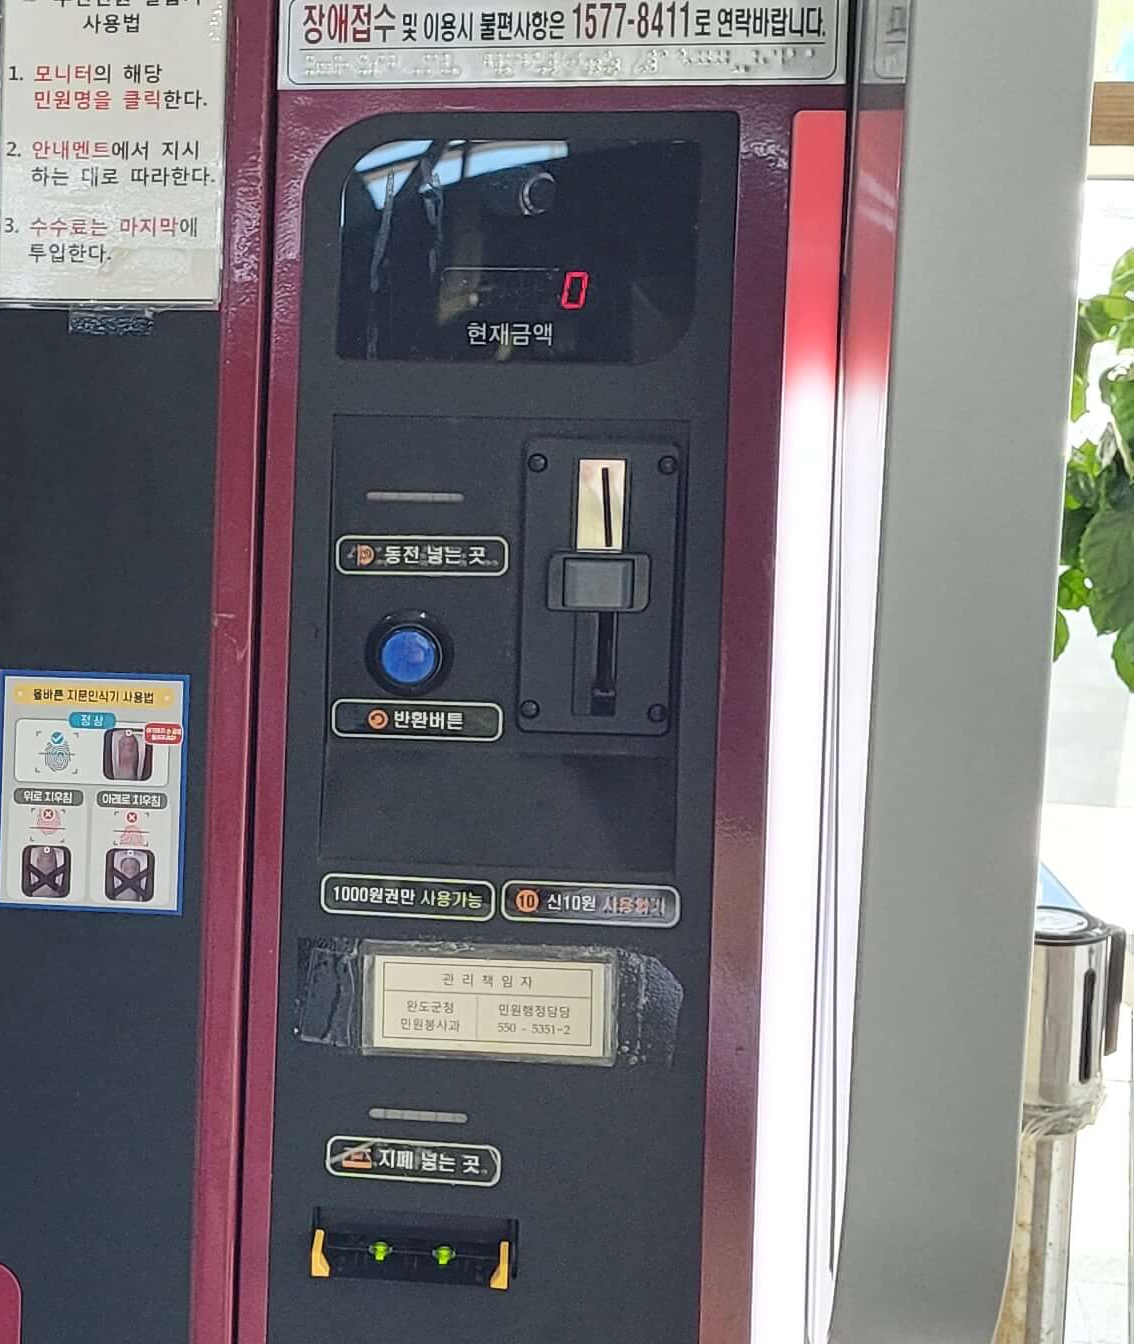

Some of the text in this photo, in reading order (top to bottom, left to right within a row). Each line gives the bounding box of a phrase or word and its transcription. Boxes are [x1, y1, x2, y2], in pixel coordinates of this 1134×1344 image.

[82, 13, 141, 35] 사용법
[302, 2, 396, 44] 장애접수
[401, 13, 417, 42] 및
[423, 12, 474, 43] 이용시
[479, 9, 566, 42] 불편사항은
[716, 5, 826, 40] 연락바랍니다.
[8, 63, 163, 85] 1. 모니터의 해당
[33, 89, 208, 111] 민원명을 클릭한다.
[6, 139, 201, 161] 2. 안내멘트에서 지시
[31, 166, 215, 187] 하는 대로 따라한다.
[3, 216, 198, 238] 3. 수수료는 마지막에
[27, 243, 112, 265] 투입한다.
[561, 271, 588, 309] 0
[466, 322, 553, 346] 현재금액
[384, 545, 486, 566] 동전 넣는 곳
[67, 689, 119, 704] 지문인식기
[123, 691, 154, 705] 사용법
[393, 710, 464, 731] 반환버튼
[333, 885, 483, 910] 1000원권만 사용가능
[547, 894, 596, 913] 신10원
[407, 1000, 454, 1015] 완도군청
[498, 1003, 570, 1019] 민원행정담당
[400, 1017, 460, 1034] 민원봉사과
[378, 1149, 481, 1175] 지폐 넣는 곳
